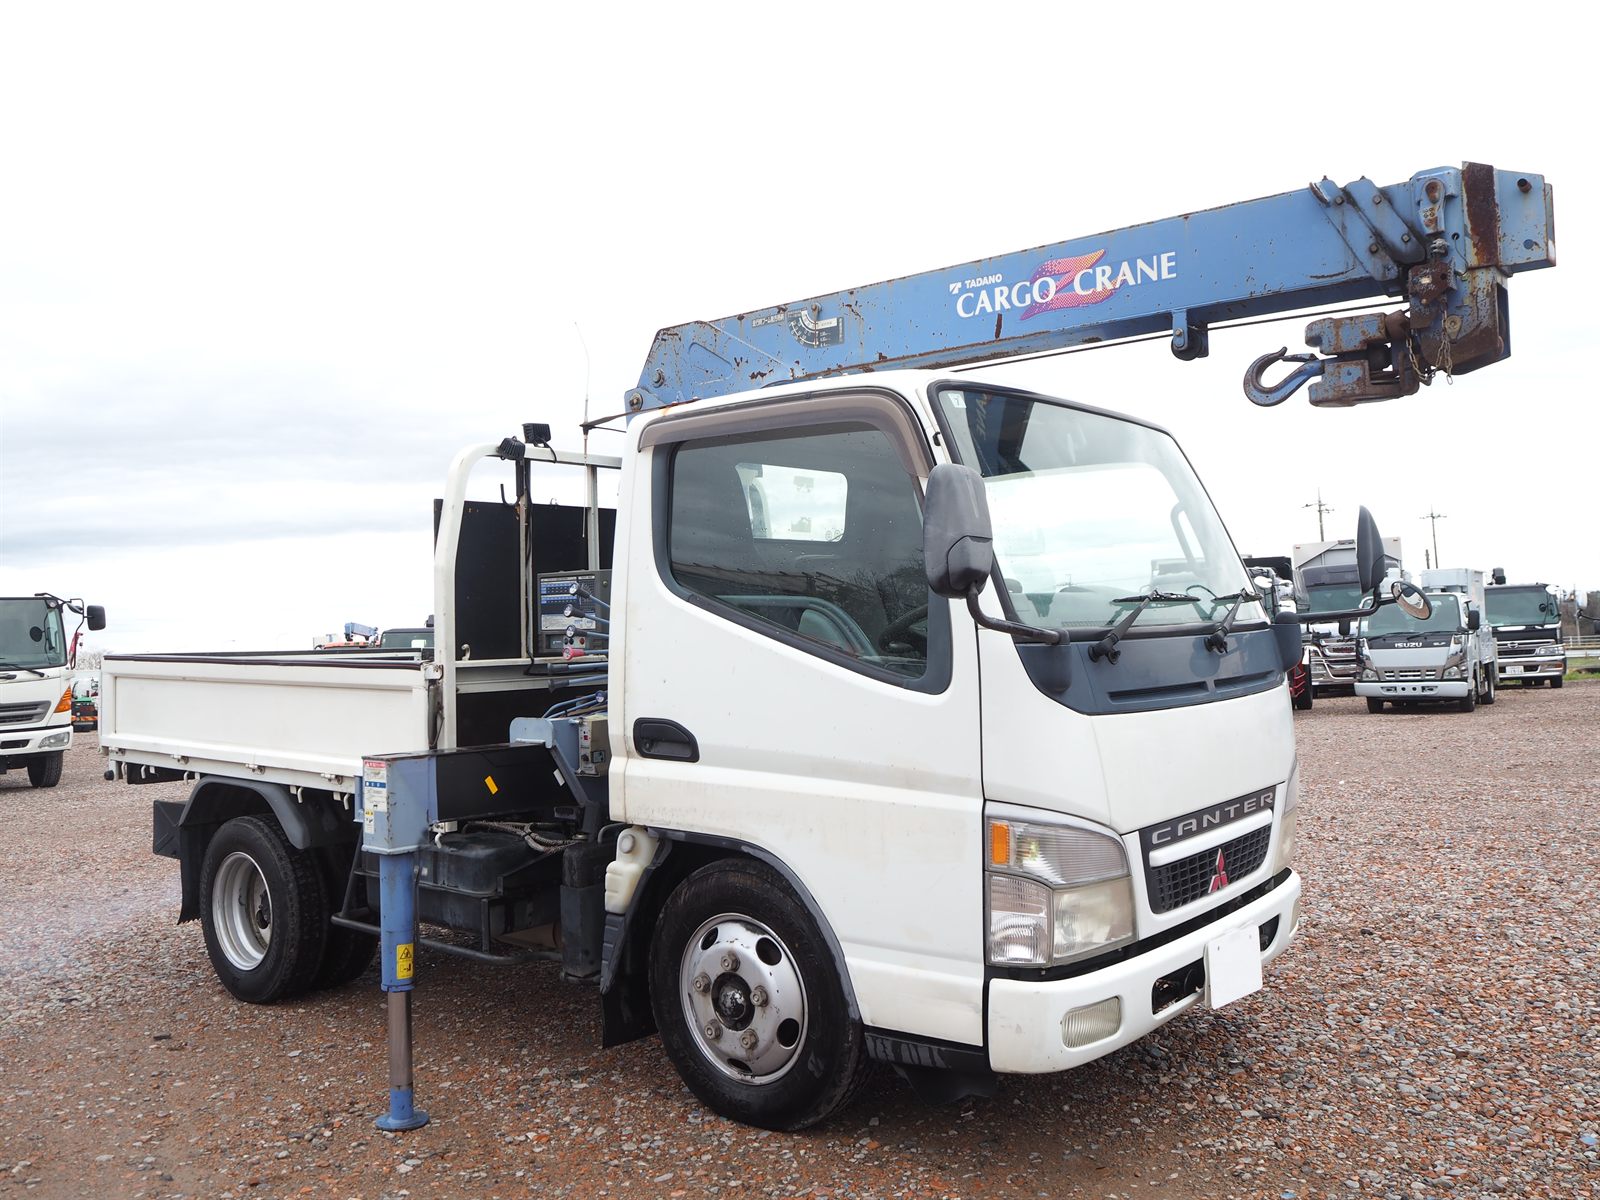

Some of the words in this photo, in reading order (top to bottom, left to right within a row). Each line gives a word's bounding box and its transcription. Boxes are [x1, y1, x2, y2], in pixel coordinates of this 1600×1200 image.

[956, 276, 1056, 318] CARGO
[1073, 251, 1177, 296] CRANE
[964, 273, 1003, 289] TADANO
[1151, 791, 1274, 845] CANTER
